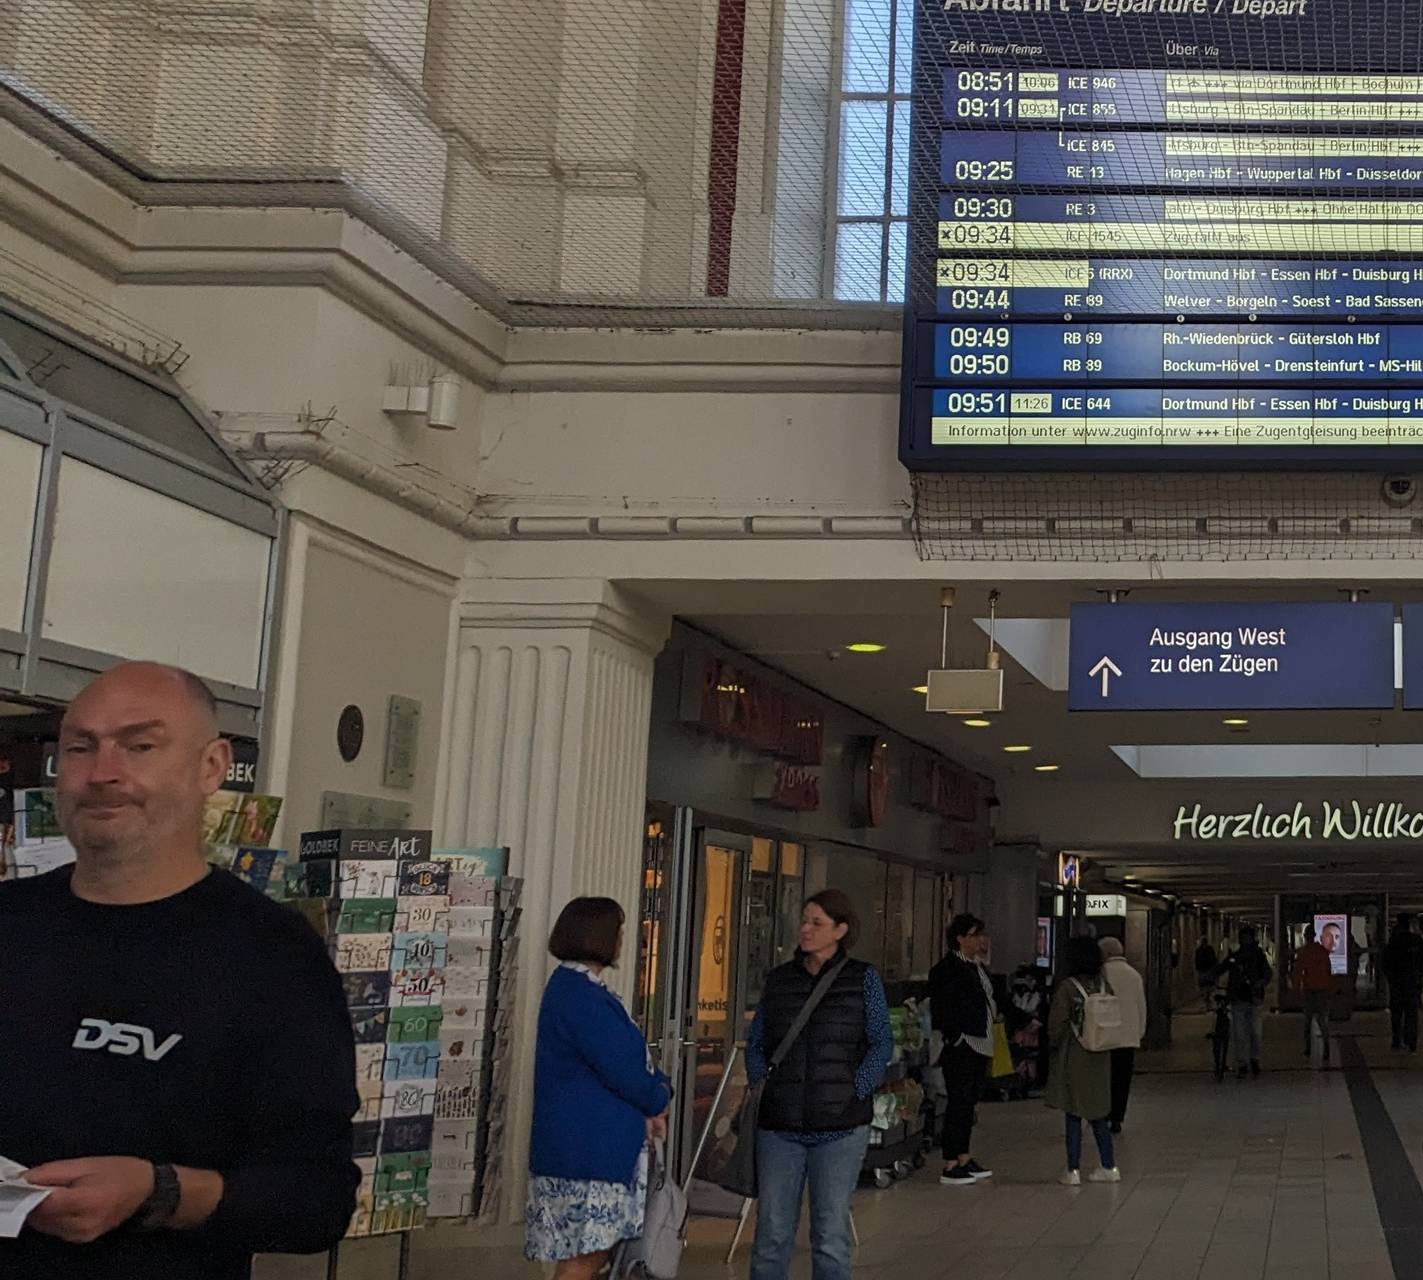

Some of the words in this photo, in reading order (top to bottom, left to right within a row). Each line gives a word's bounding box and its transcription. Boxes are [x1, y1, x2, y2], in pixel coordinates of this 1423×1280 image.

[1084, 0, 1208, 17] Departure
[949, 41, 975, 54] Zeit
[980, 44, 1042, 55] Time/Temps
[1166, 40, 1198, 56] Über
[1204, 46, 1219, 56] Via
[957, 71, 1014, 91] 08:51
[1068, 78, 1088, 89] ICE
[1092, 77, 1116, 89] 946
[957, 98, 1014, 118] 09:11
[1068, 104, 1087, 115] ICE
[1092, 104, 1116, 115] 855
[1067, 140, 1087, 151] ICE
[1092, 140, 1115, 152] 845
[956, 161, 1013, 180] 09:25
[1067, 166, 1084, 178] RE
[1089, 166, 1104, 178] 13
[1165, 168, 1205, 181] Hagen
[1210, 168, 1232, 179] Hbf
[1248, 168, 1313, 182] Wuppertal
[1320, 168, 1341, 180] Hbf
[954, 198, 1013, 218] 09:30
[1066, 203, 1083, 215] RE
[954, 226, 1010, 244] 09:34
[953, 263, 1010, 281] 09:34
[1099, 268, 1133, 280] (RRX)
[1165, 268, 1229, 280] Dortmund
[1233, 268, 1256, 280] Hbf
[1271, 268, 1310, 281] Essen
[1315, 268, 1337, 280] Hbf
[1353, 268, 1409, 283] Duisburg
[952, 290, 1010, 309] 09:44
[1065, 295, 1081, 306] RE
[1164, 294, 1214, 306] Welver
[1227, 294, 1277, 309] Borgeln
[1292, 295, 1330, 307] Soest
[1346, 295, 1369, 307] Bad
[951, 328, 1009, 347] 09:49
[1064, 332, 1082, 344] RB
[1086, 332, 1102, 344] 69
[1163, 332, 1273, 345] Rh.-Wiedenbrück
[1289, 332, 1353, 345] Gütersloh
[1358, 332, 1380, 345] Hbf
[950, 355, 1009, 374] 09:50
[1064, 360, 1081, 371] RB
[1086, 360, 1102, 371] 89
[1163, 359, 1259, 372] Bockum-Hövel
[1275, 359, 1364, 372] Drensteinfurt
[949, 393, 1006, 413] 09:51
[1014, 398, 1048, 410] 11:26
[1062, 398, 1082, 410] ICE
[1087, 398, 1111, 410] 644
[1162, 397, 1227, 410] Dortmund
[1231, 397, 1254, 410] Hbf
[1270, 398, 1310, 411] Essen
[1315, 398, 1337, 410] Hbf
[1353, 398, 1410, 414] Duisburg
[949, 424, 1026, 437] Information
[1032, 426, 1066, 437] unter
[1073, 425, 1191, 441] www.zuginfo.nrw
[1225, 425, 1251, 438] Eine
[1256, 425, 1357, 441] Zugentgleisung
[1150, 628, 1232, 649] Ausgang
[1238, 627, 1286, 645] West
[1151, 659, 1172, 672] zu
[1178, 655, 1212, 672] den
[1219, 654, 1278, 675] Zügen
[1174, 801, 1312, 840] Herzlich
[419, 873, 431, 885] 18
[413, 908, 431, 921] 30
[414, 943, 430, 957] 10
[408, 978, 429, 992] 50
[72, 1018, 183, 1062] DSV
